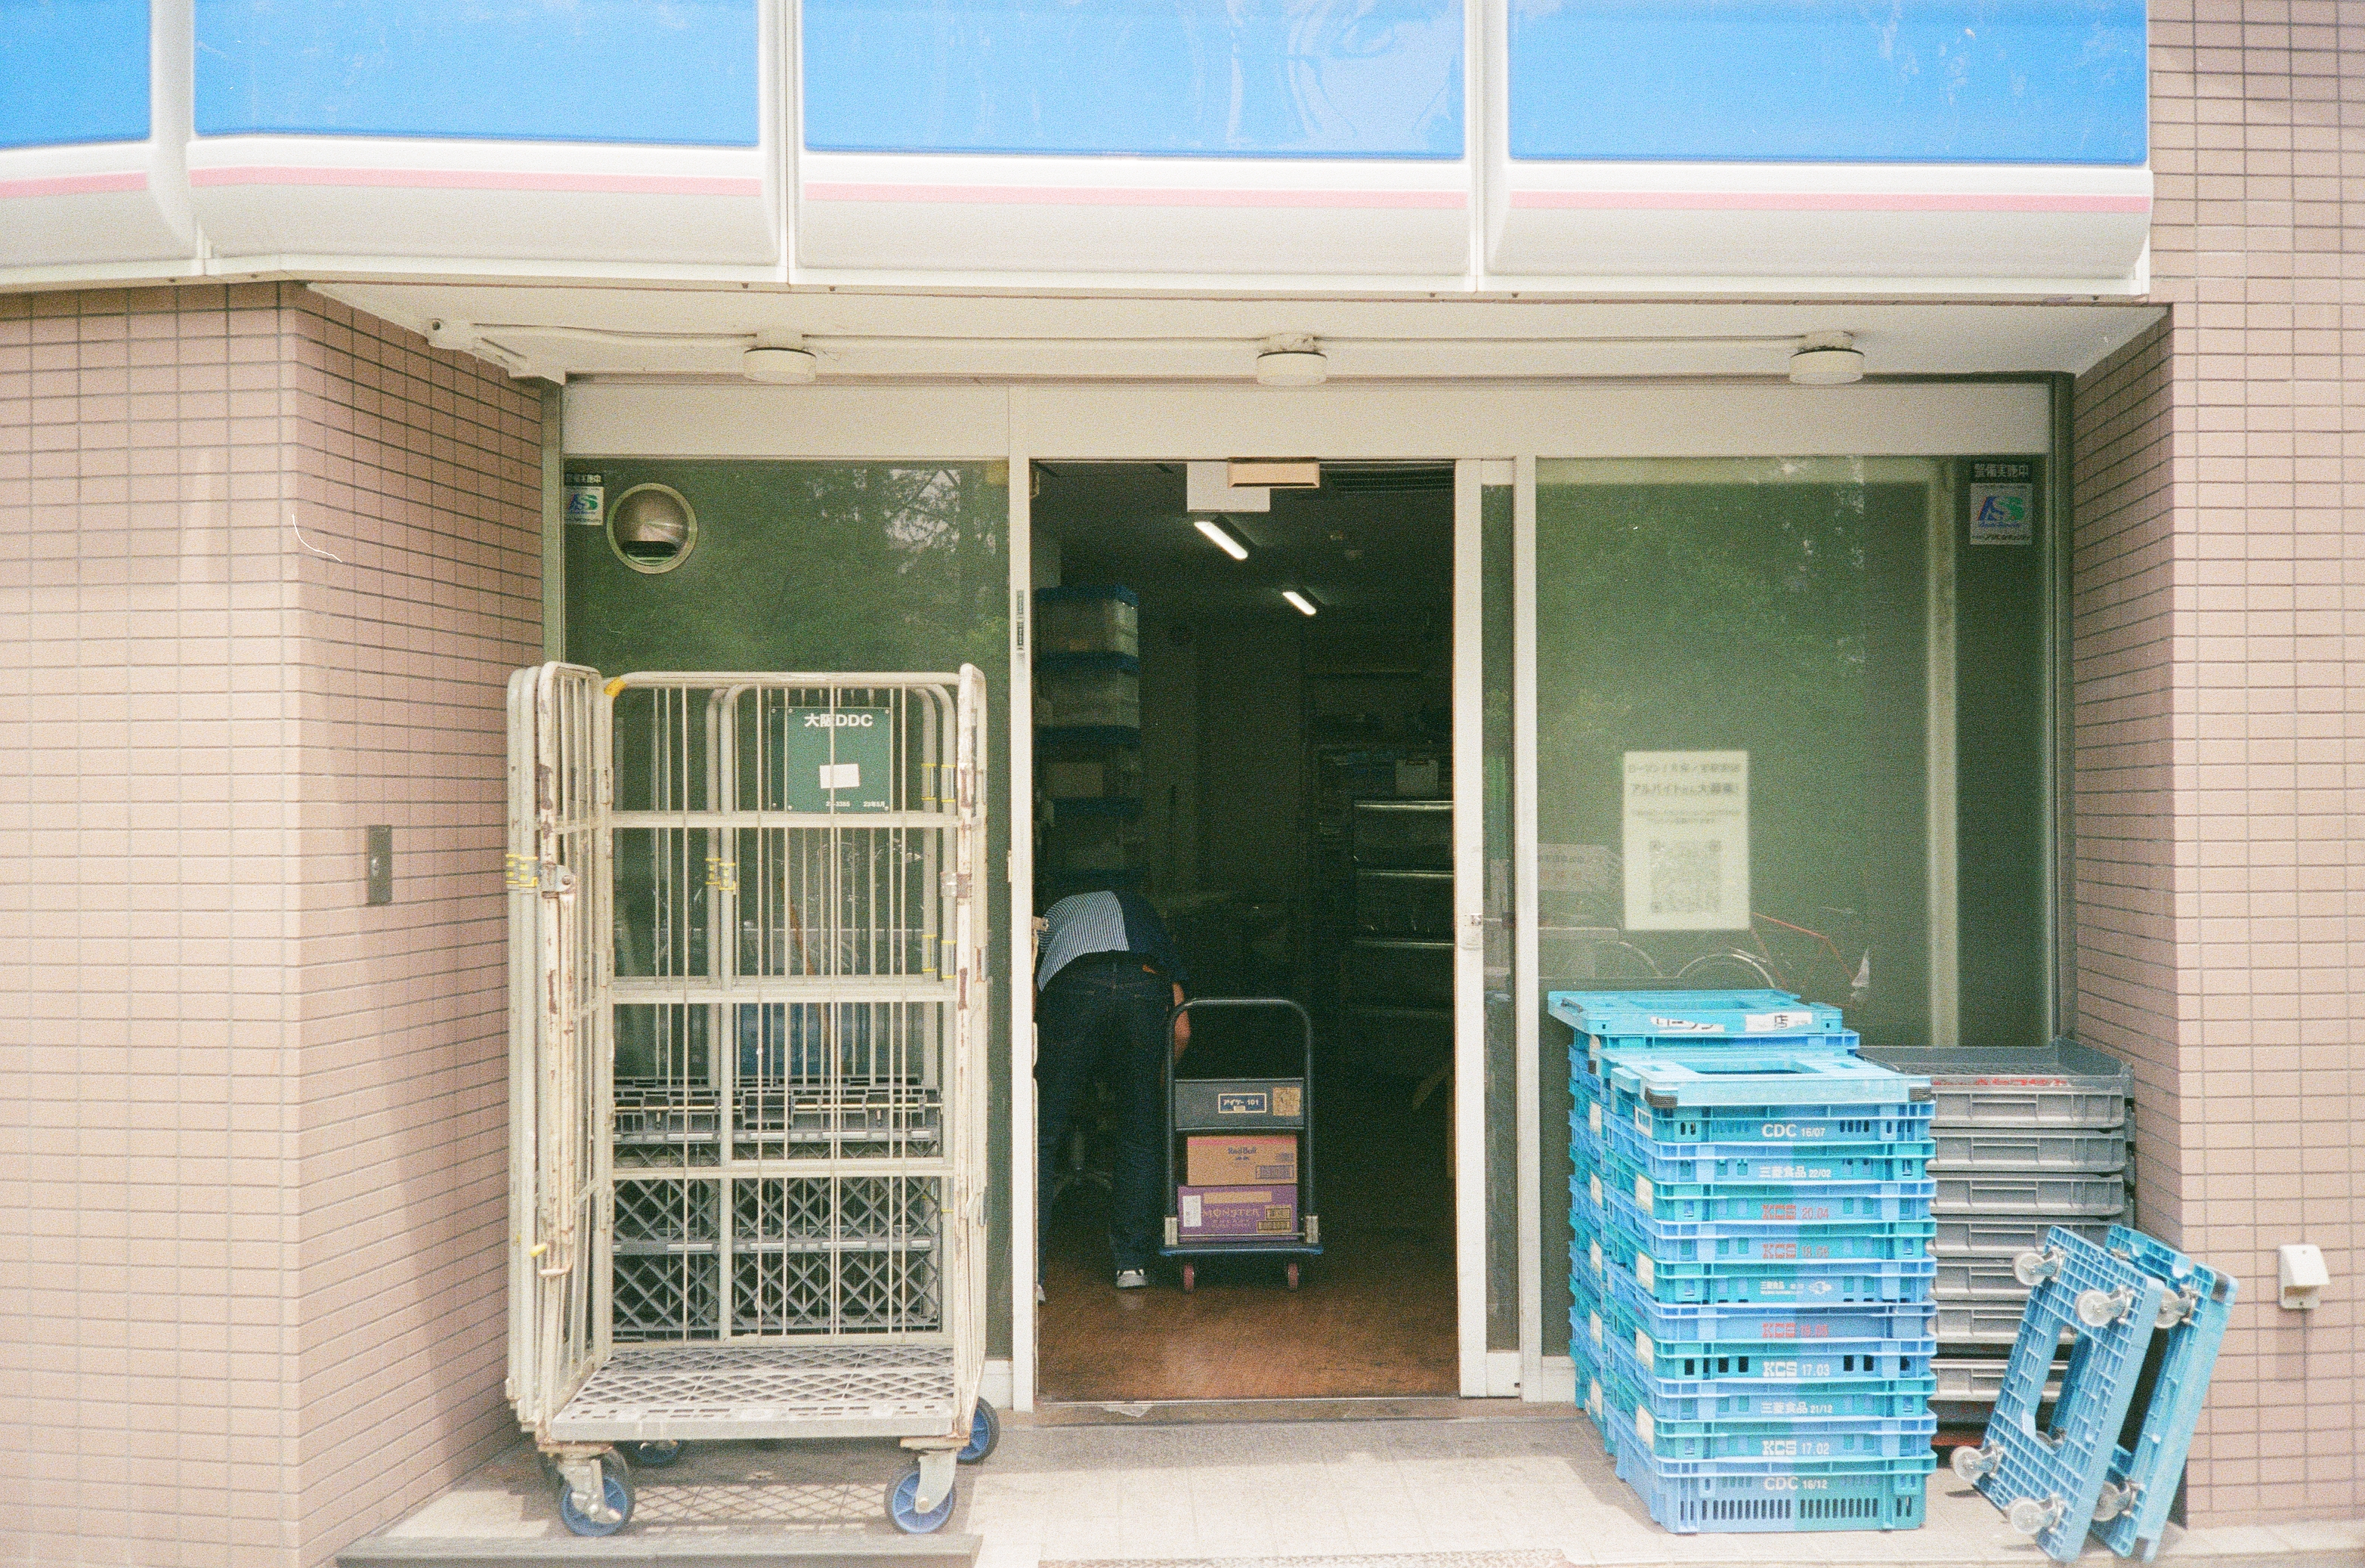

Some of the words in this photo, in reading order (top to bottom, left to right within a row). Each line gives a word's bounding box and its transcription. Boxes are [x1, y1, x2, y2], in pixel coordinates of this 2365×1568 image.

[1761, 1123, 1797, 1138] CDC
[1801, 1127, 1826, 1137] 16/07
[1759, 1165, 1807, 1178] 三菱食品
[1808, 1168, 1832, 1178] 22/02
[1801, 1207, 1829, 1220] 20.04
[1802, 1363, 1830, 1377] 17.03
[1761, 1401, 1808, 1414] 三菱食品
[1810, 1404, 1833, 1414] 21/12
[1801, 1442, 1830, 1455] 17.02
[1764, 1476, 1799, 1491] CDC
